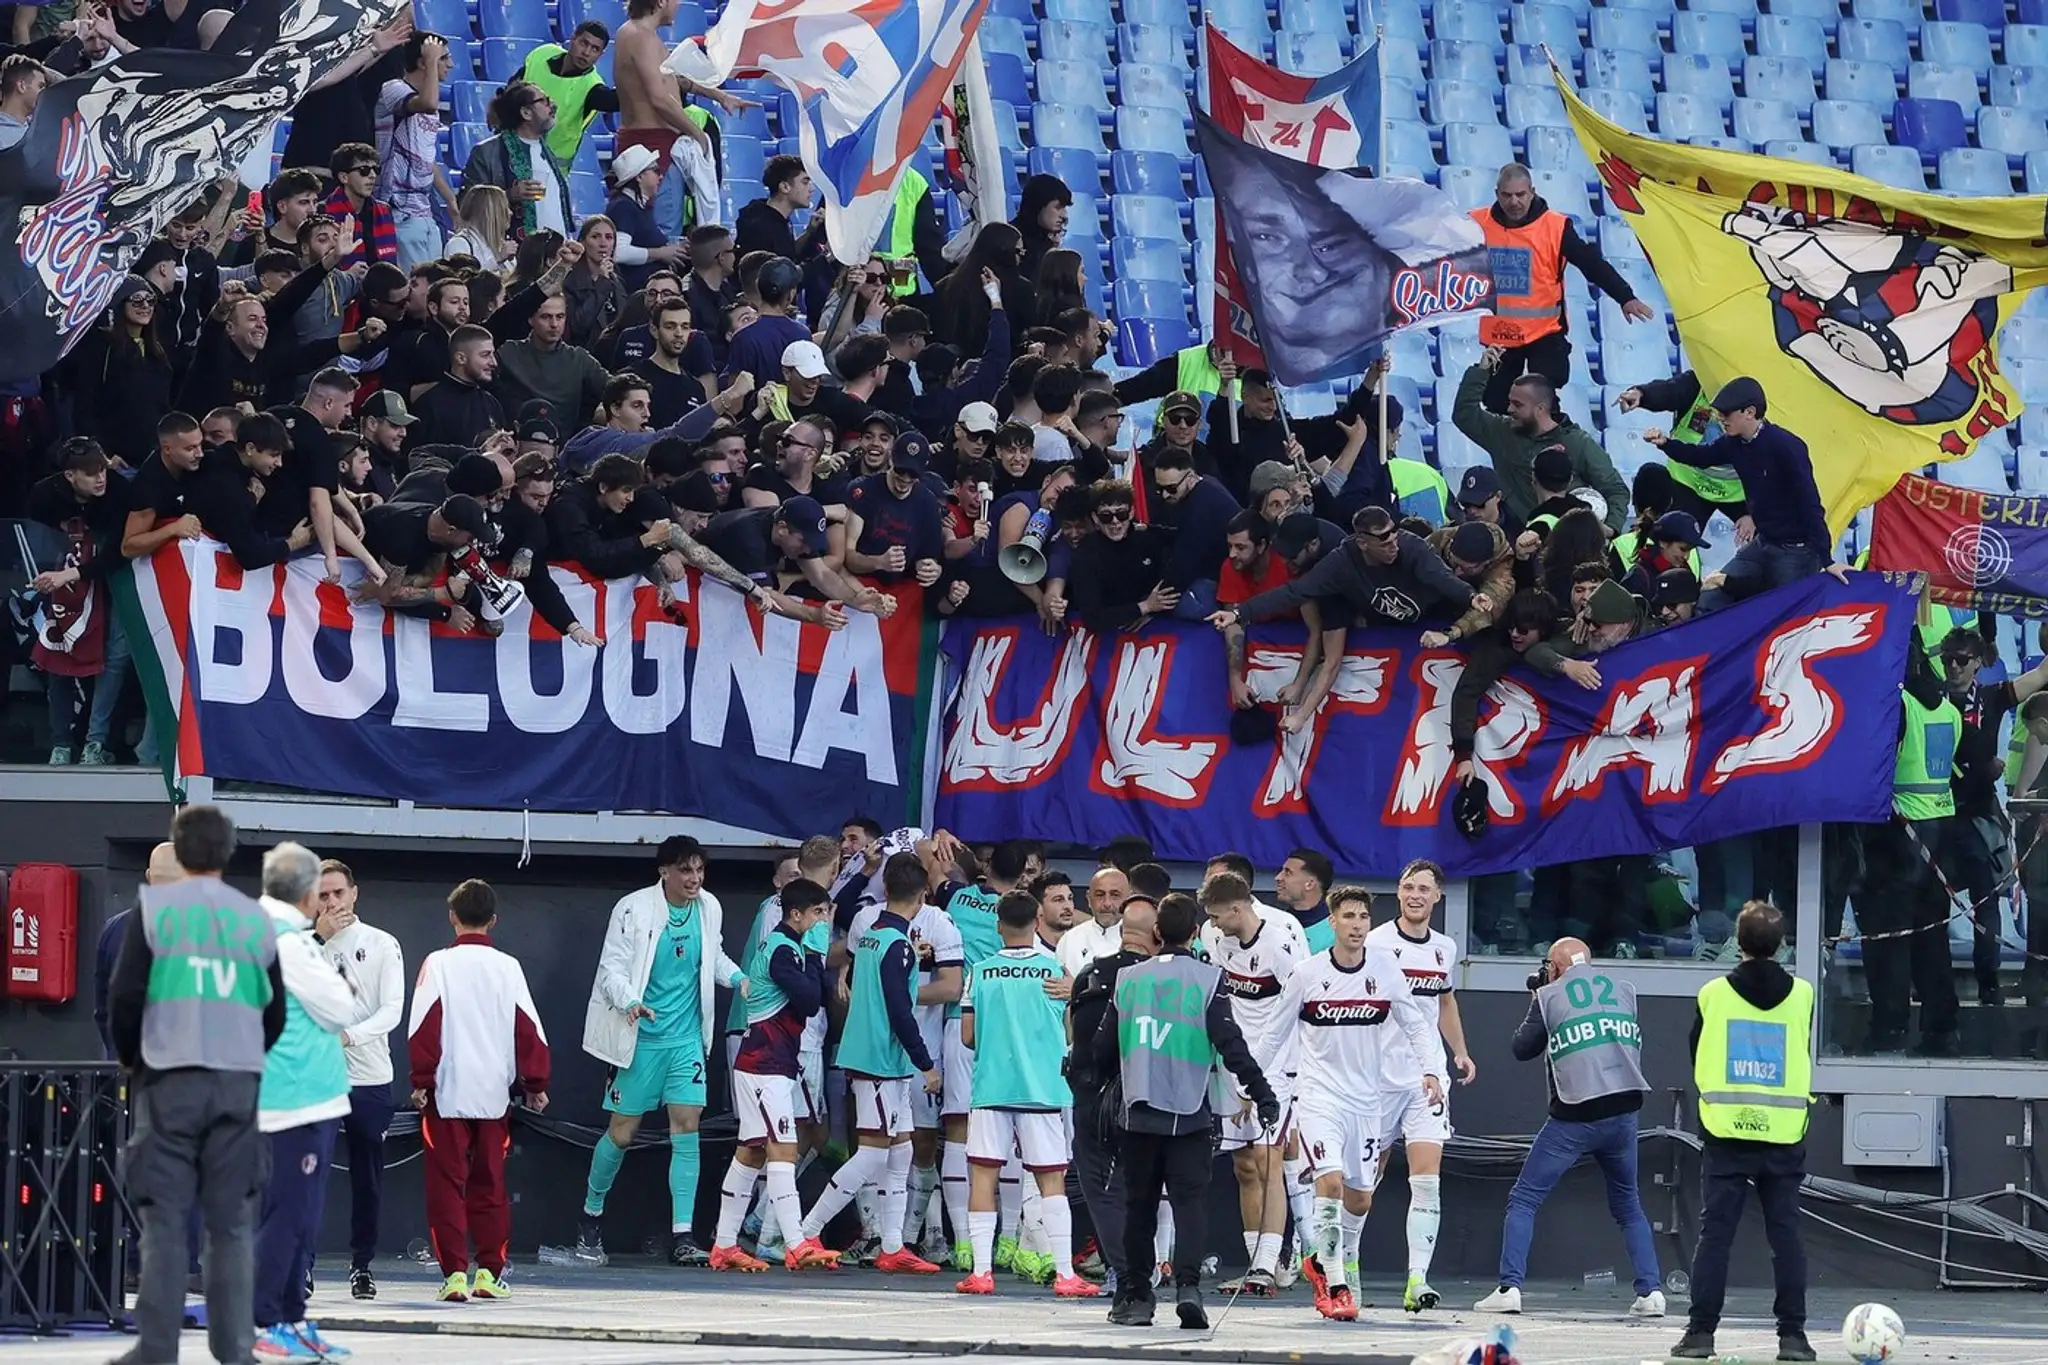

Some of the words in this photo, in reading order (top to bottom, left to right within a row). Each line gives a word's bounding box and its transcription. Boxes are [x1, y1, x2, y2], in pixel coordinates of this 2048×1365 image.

[1270, 122, 1303, 147] 74
[1394, 260, 1490, 324] Salsa
[1906, 475, 2048, 527] OSTERI
[180, 535, 899, 786] BOLOGNA
[942, 606, 1883, 820] ULTRAS
[956, 894, 997, 914] macr
[187, 956, 237, 998] TV
[983, 966, 1052, 980] macron
[1565, 975, 1619, 1009] 02
[1315, 1002, 1380, 1023] Saputo
[1136, 1016, 1173, 1050] TV
[1549, 1022, 1596, 1054] CLUB
[1598, 1018, 1642, 1043] PHOT
[1733, 1060, 1777, 1080] W1032
